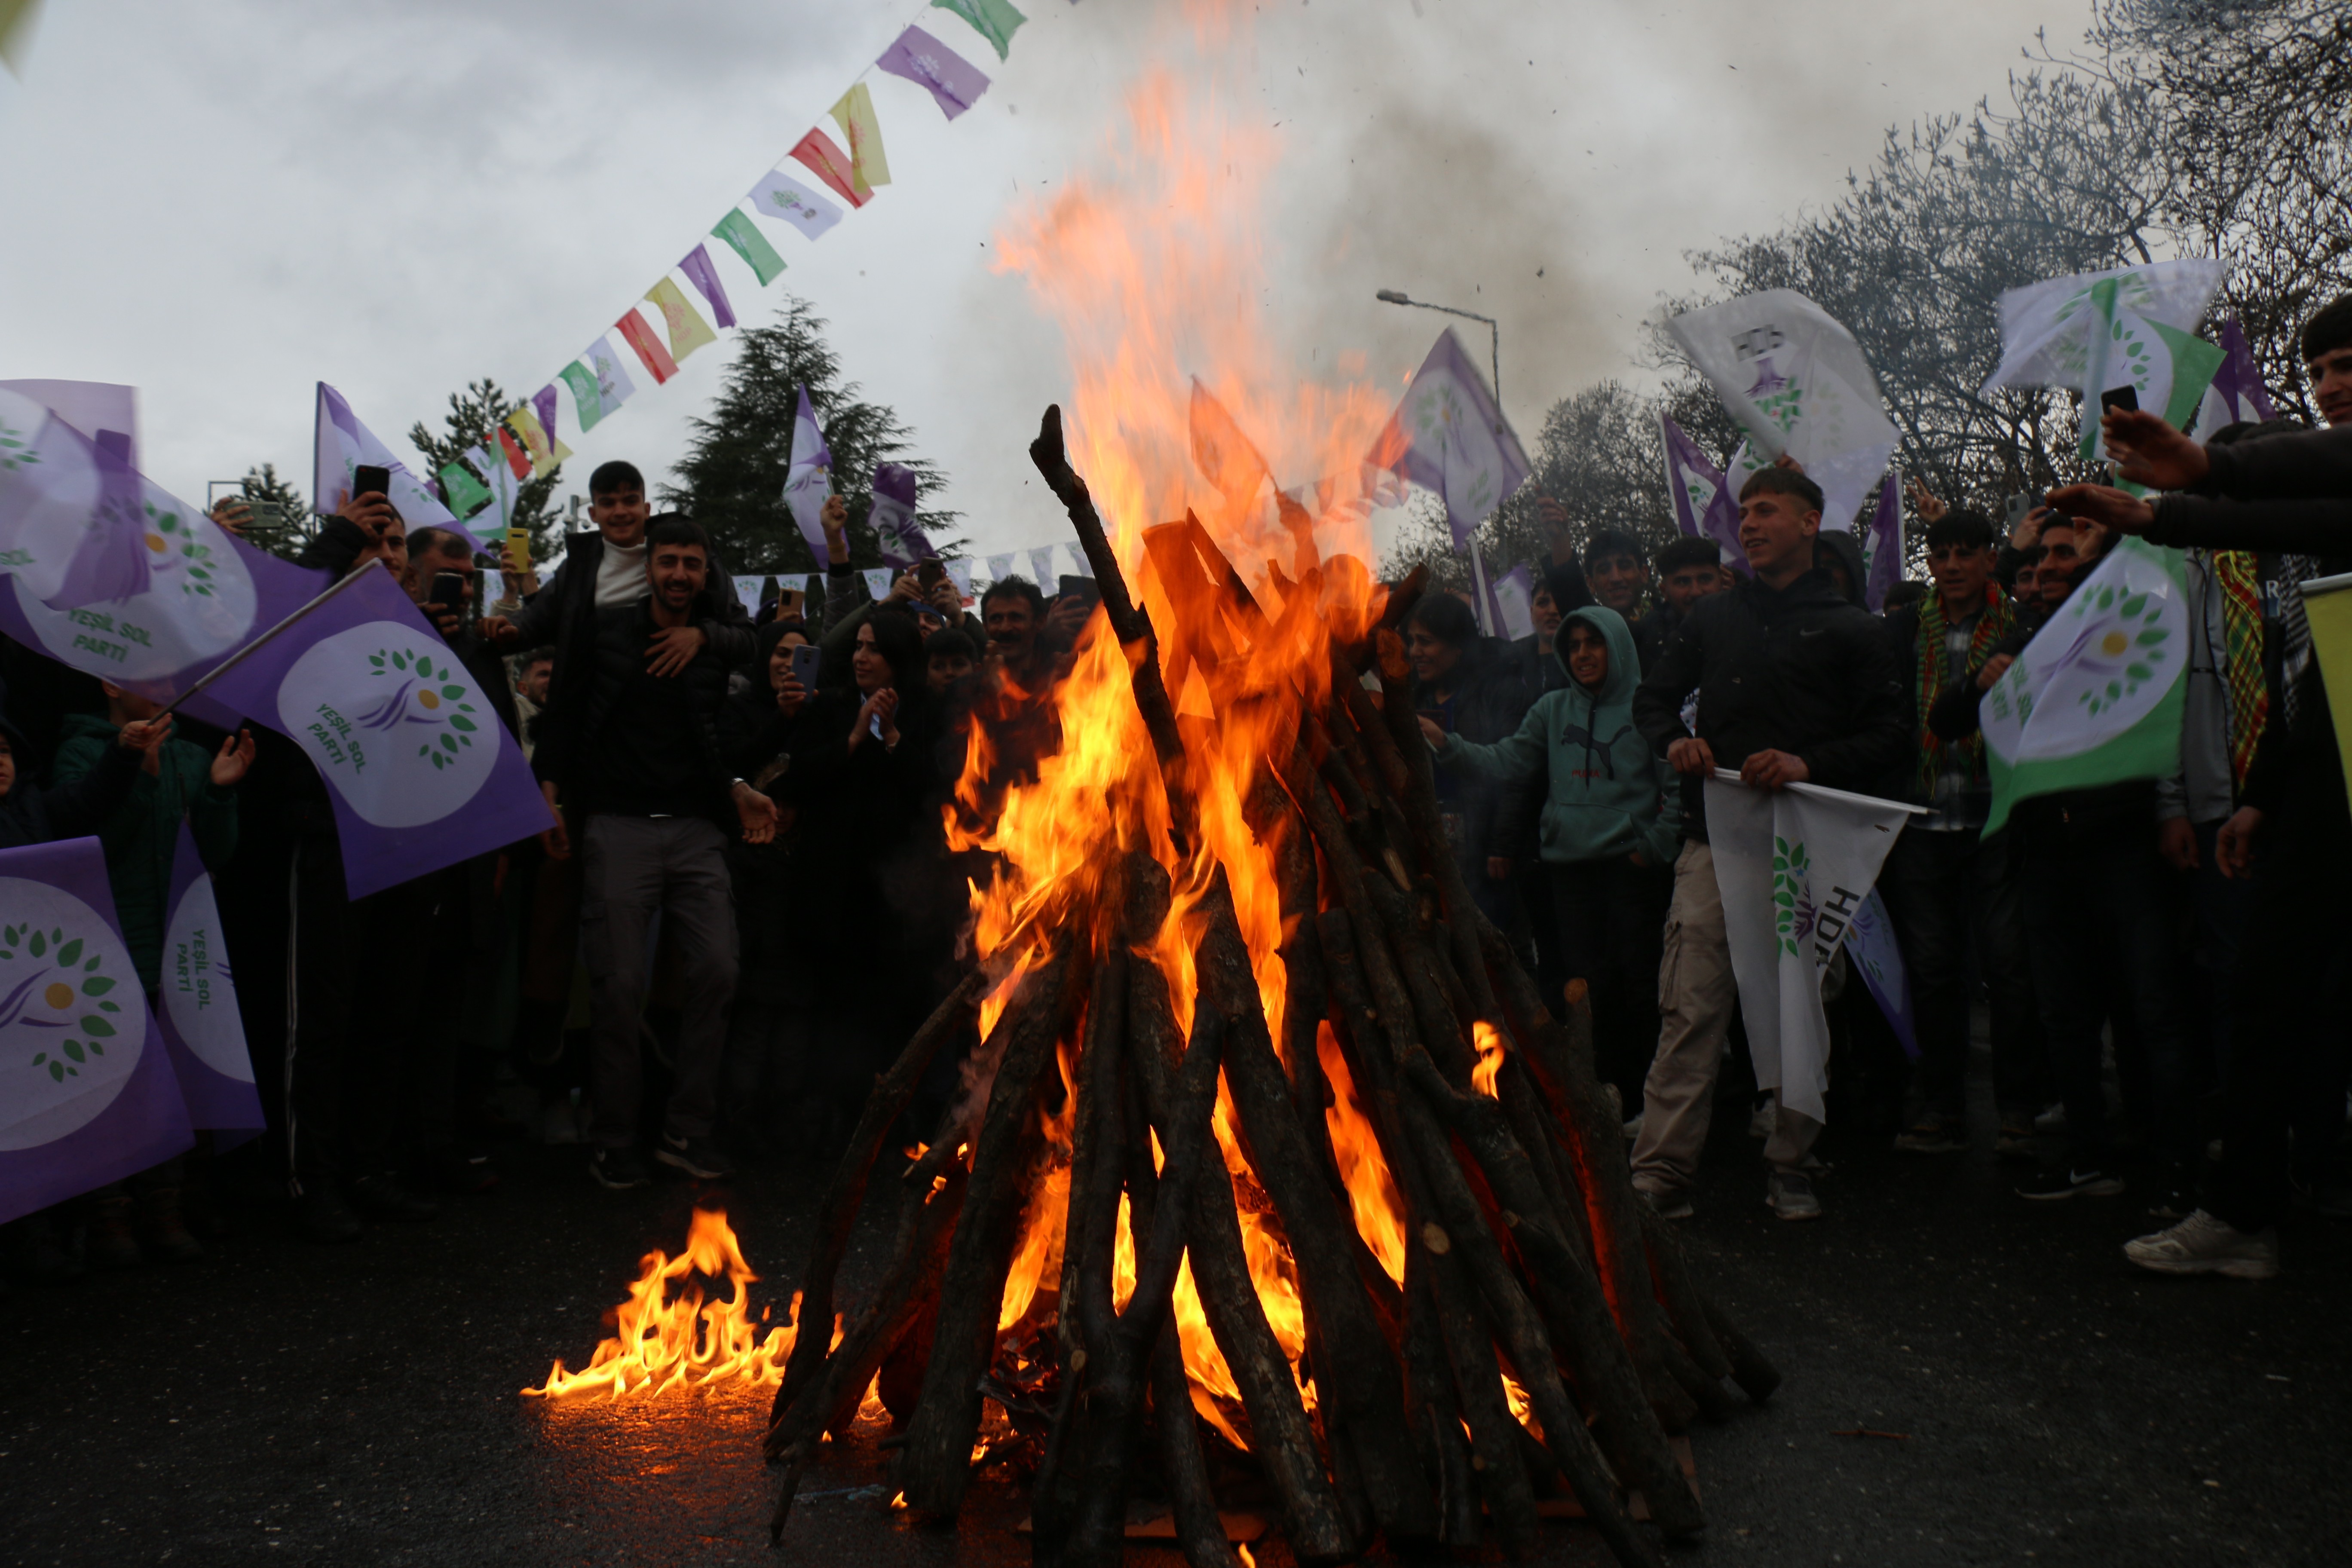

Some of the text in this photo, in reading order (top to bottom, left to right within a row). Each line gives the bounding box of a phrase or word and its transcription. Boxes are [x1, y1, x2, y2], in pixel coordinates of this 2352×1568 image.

[306, 723, 348, 765] PARTİ
[316, 703, 366, 774] YEŞİL SOL
[177, 943, 193, 992] PARTİ
[191, 929, 211, 1011] YEŞİL SOL
